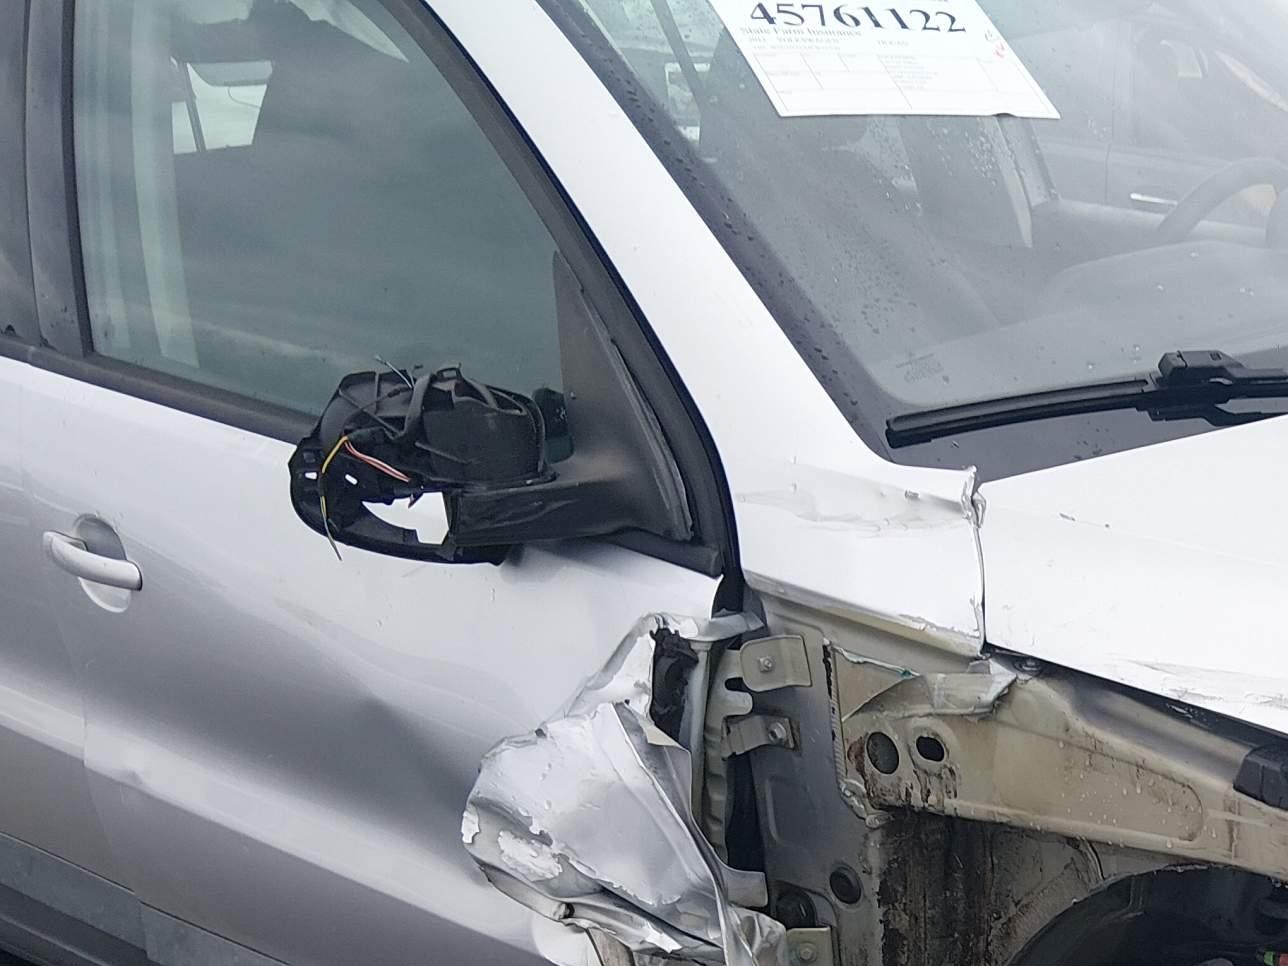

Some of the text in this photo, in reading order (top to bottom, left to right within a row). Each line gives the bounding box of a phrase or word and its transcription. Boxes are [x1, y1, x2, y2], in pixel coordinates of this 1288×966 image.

[749, 2, 967, 33] 45761122
[740, 27, 862, 37] State Farm Insurance
